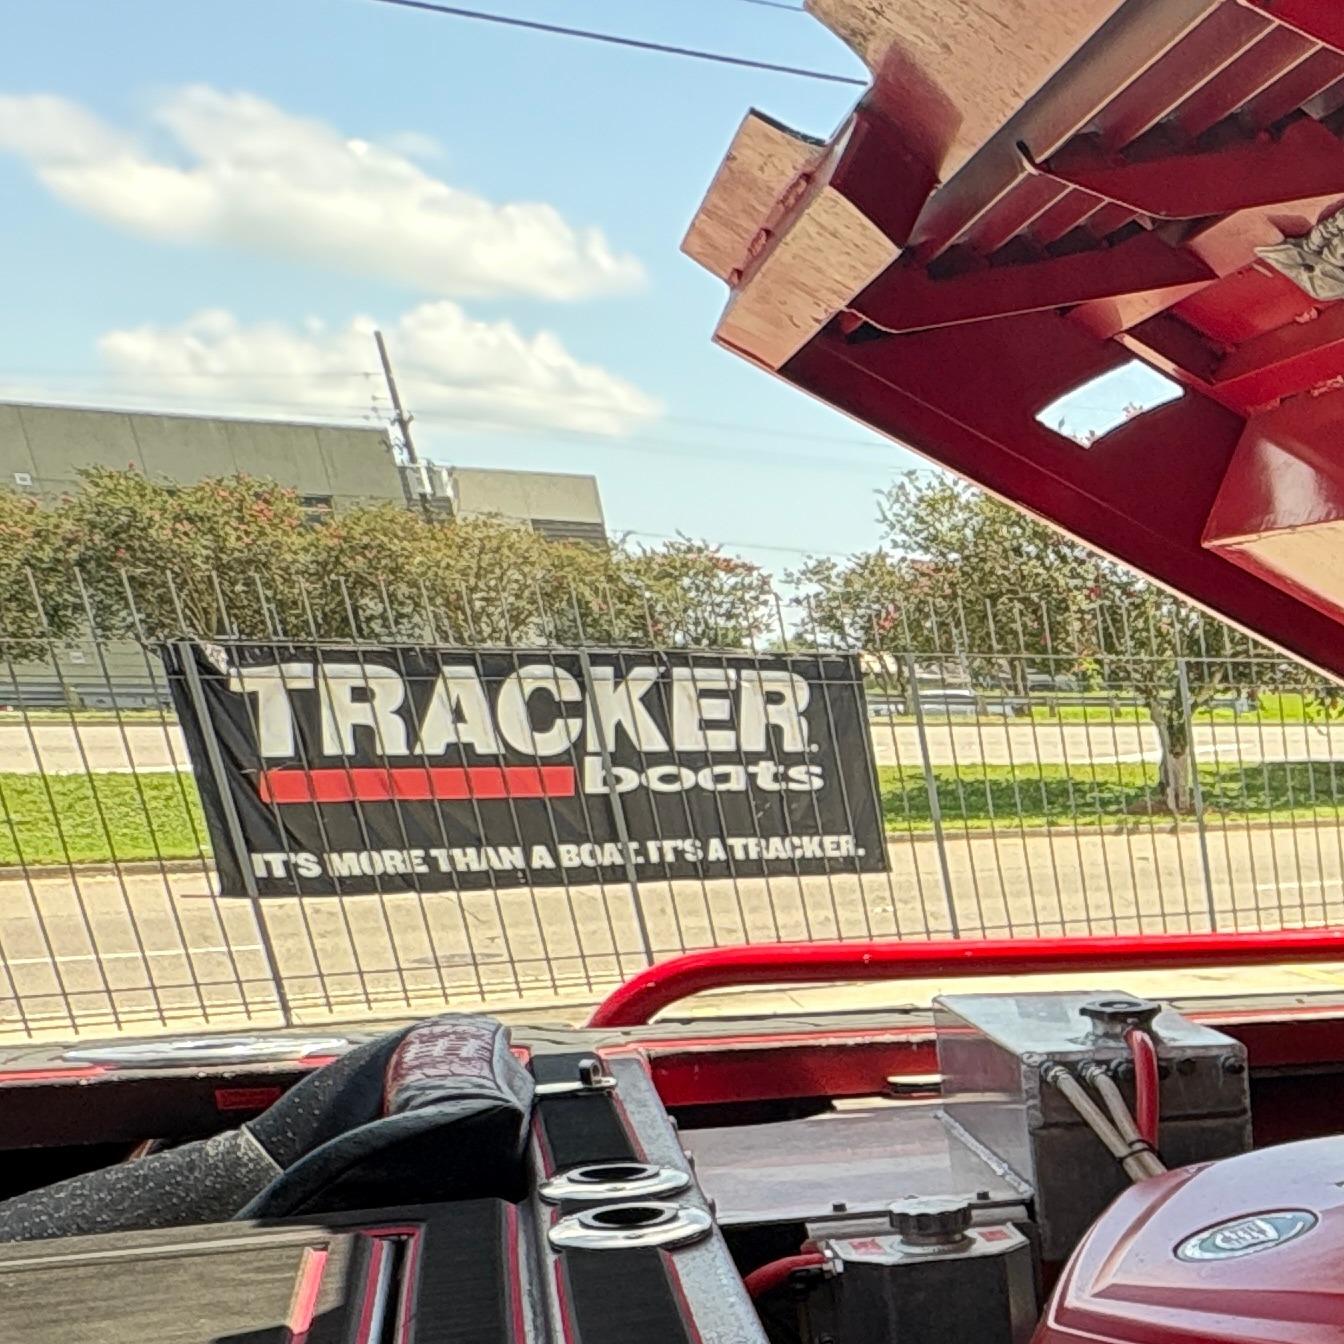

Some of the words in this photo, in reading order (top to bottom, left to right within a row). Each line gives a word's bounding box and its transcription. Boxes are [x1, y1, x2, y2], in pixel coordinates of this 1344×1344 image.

[584, 756, 824, 794] boats
[251, 852, 322, 878] IT'S
[324, 849, 429, 876] MORE
[430, 846, 526, 873] THAN
[531, 844, 556, 869] A
[561, 841, 645, 868] BOAT.
[647, 837, 704, 864] IT'S
[707, 837, 728, 862] A
[726, 834, 866, 860] TRACKER.
